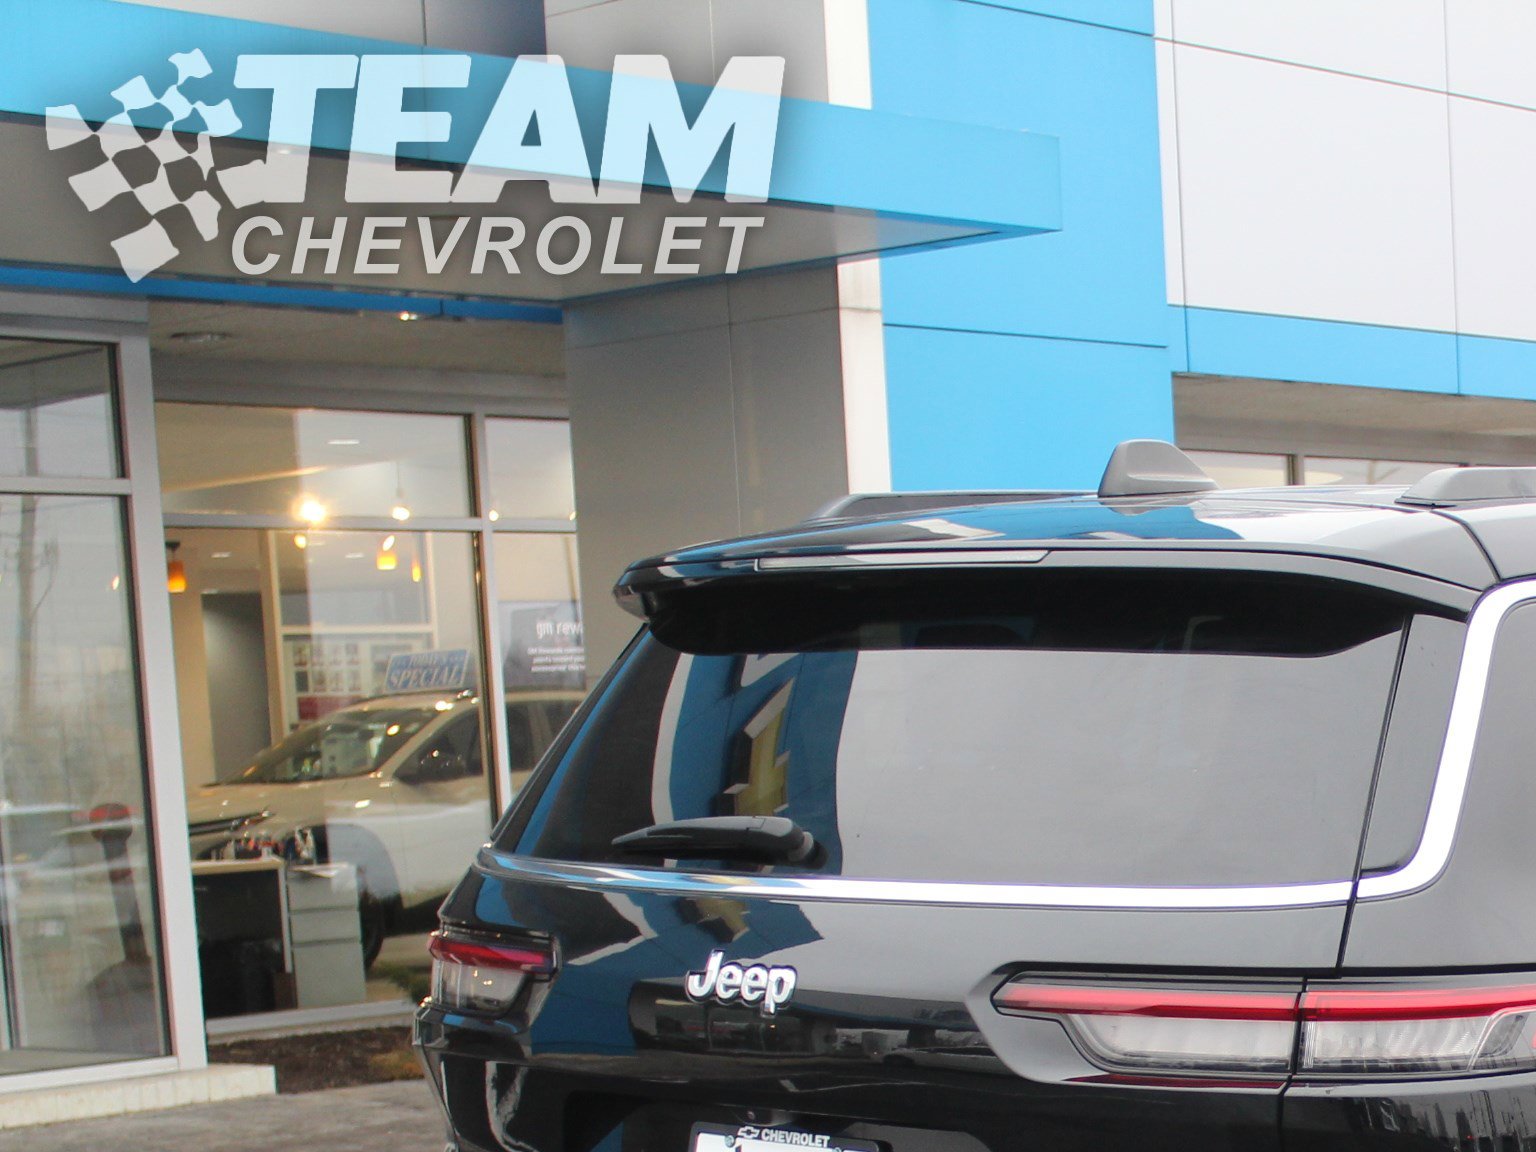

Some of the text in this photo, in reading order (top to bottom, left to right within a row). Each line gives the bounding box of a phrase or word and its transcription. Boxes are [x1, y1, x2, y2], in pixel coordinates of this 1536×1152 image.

[389, 666, 463, 688] SPECIAL
[686, 949, 797, 1017] Jeep
[761, 1128, 831, 1149] CHEVROLET
